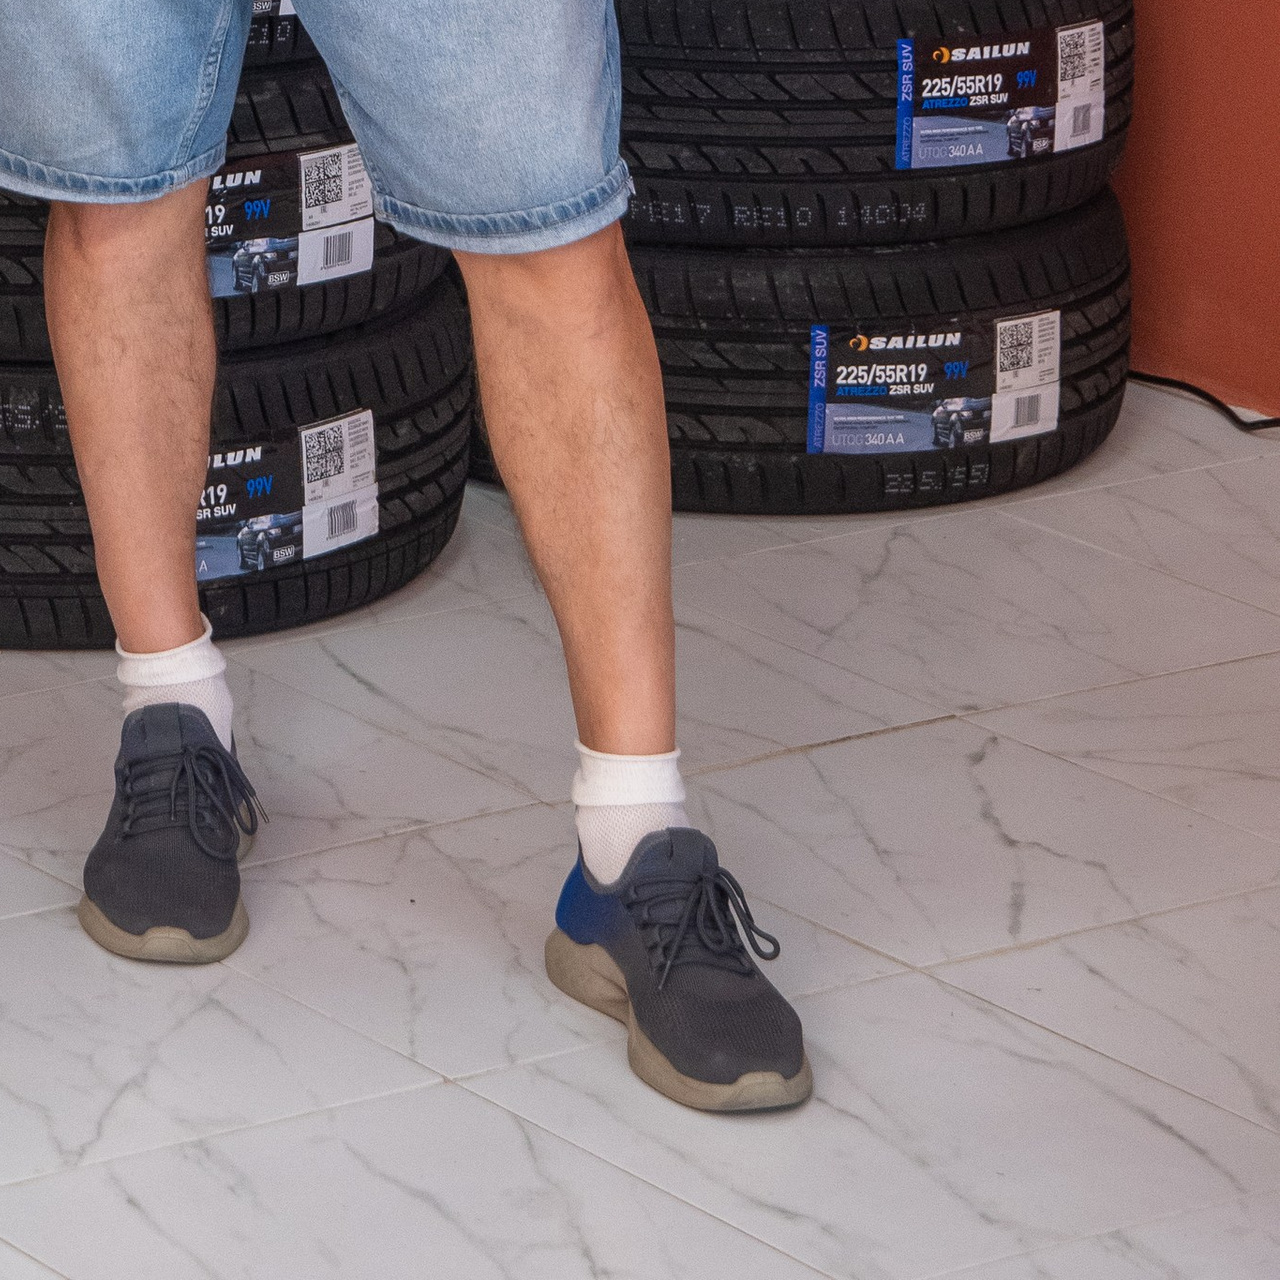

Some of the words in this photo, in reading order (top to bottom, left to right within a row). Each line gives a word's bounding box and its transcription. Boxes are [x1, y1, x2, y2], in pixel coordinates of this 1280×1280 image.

[903, 44, 913, 70] SUV
[951, 42, 1030, 61] SAILUN
[902, 75, 912, 101] ZSR
[922, 74, 1002, 97] 225/55R19
[1017, 70, 1036, 88] 99V
[923, 98, 968, 109] ATREZZO
[970, 96, 988, 106] ZSR
[991, 93, 1008, 104] SUV
[245, 199, 270, 220] 99V
[212, 225, 233, 236] SUV
[269, 274, 288, 282] BSW
[815, 330, 827, 356] SUV
[869, 333, 961, 349] SAILUN
[814, 361, 825, 387] ZSR
[836, 364, 927, 384] 225/55R19
[945, 362, 968, 379] 99V
[836, 386, 887, 395] ATREZZO
[890, 385, 910, 394] ZSR
[913, 384, 934, 393] SUV
[246, 475, 273, 498] 99V
[213, 504, 236, 516] SUV
[274, 547, 294, 559] BSW
